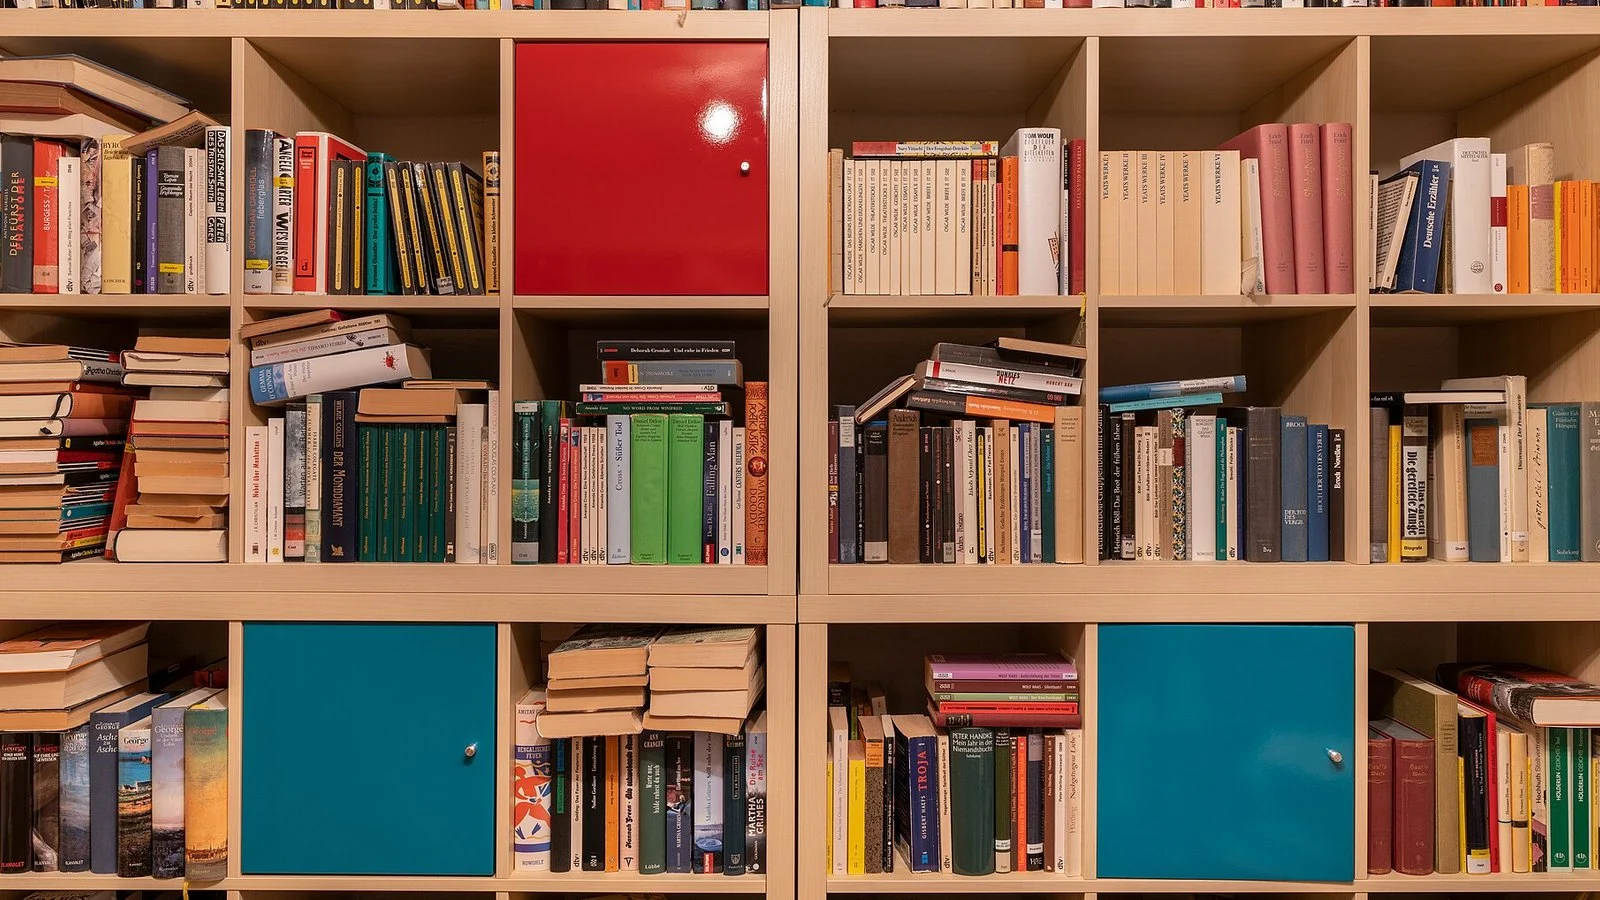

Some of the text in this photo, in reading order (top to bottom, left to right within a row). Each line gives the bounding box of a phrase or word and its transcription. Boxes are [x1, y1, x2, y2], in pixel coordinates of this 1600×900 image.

[217, 131, 226, 212] DAS SELTSAME LEBEN
[279, 140, 292, 172] ANGELA
[9, 172, 18, 256] DER FÜRST DER
[16, 177, 25, 250] PHANTOME
[257, 180, 266, 219] fieberglas
[1424, 175, 1439, 249] Deutsche Erzähler
[217, 218, 225, 242] PETER
[86, 366, 122, 376] Agatha Christie
[266, 369, 275, 400] O'CONNOR
[997, 370, 1020, 378] DUNKLES
[998, 376, 1016, 385] NETZ
[706, 441, 718, 462] Man
[332, 451, 345, 527] DER MONDDIAMANT
[706, 465, 718, 496] Falling
[1407, 451, 1418, 536] Die gerettete Zunge
[63, 731, 88, 741] George
[96, 733, 118, 742] Asche
[124, 736, 148, 745] George
[154, 725, 184, 734] George
[96, 745, 118, 753] Asche
[918, 751, 929, 791] TROJA
[1070, 754, 1078, 799] Nachgetragene
